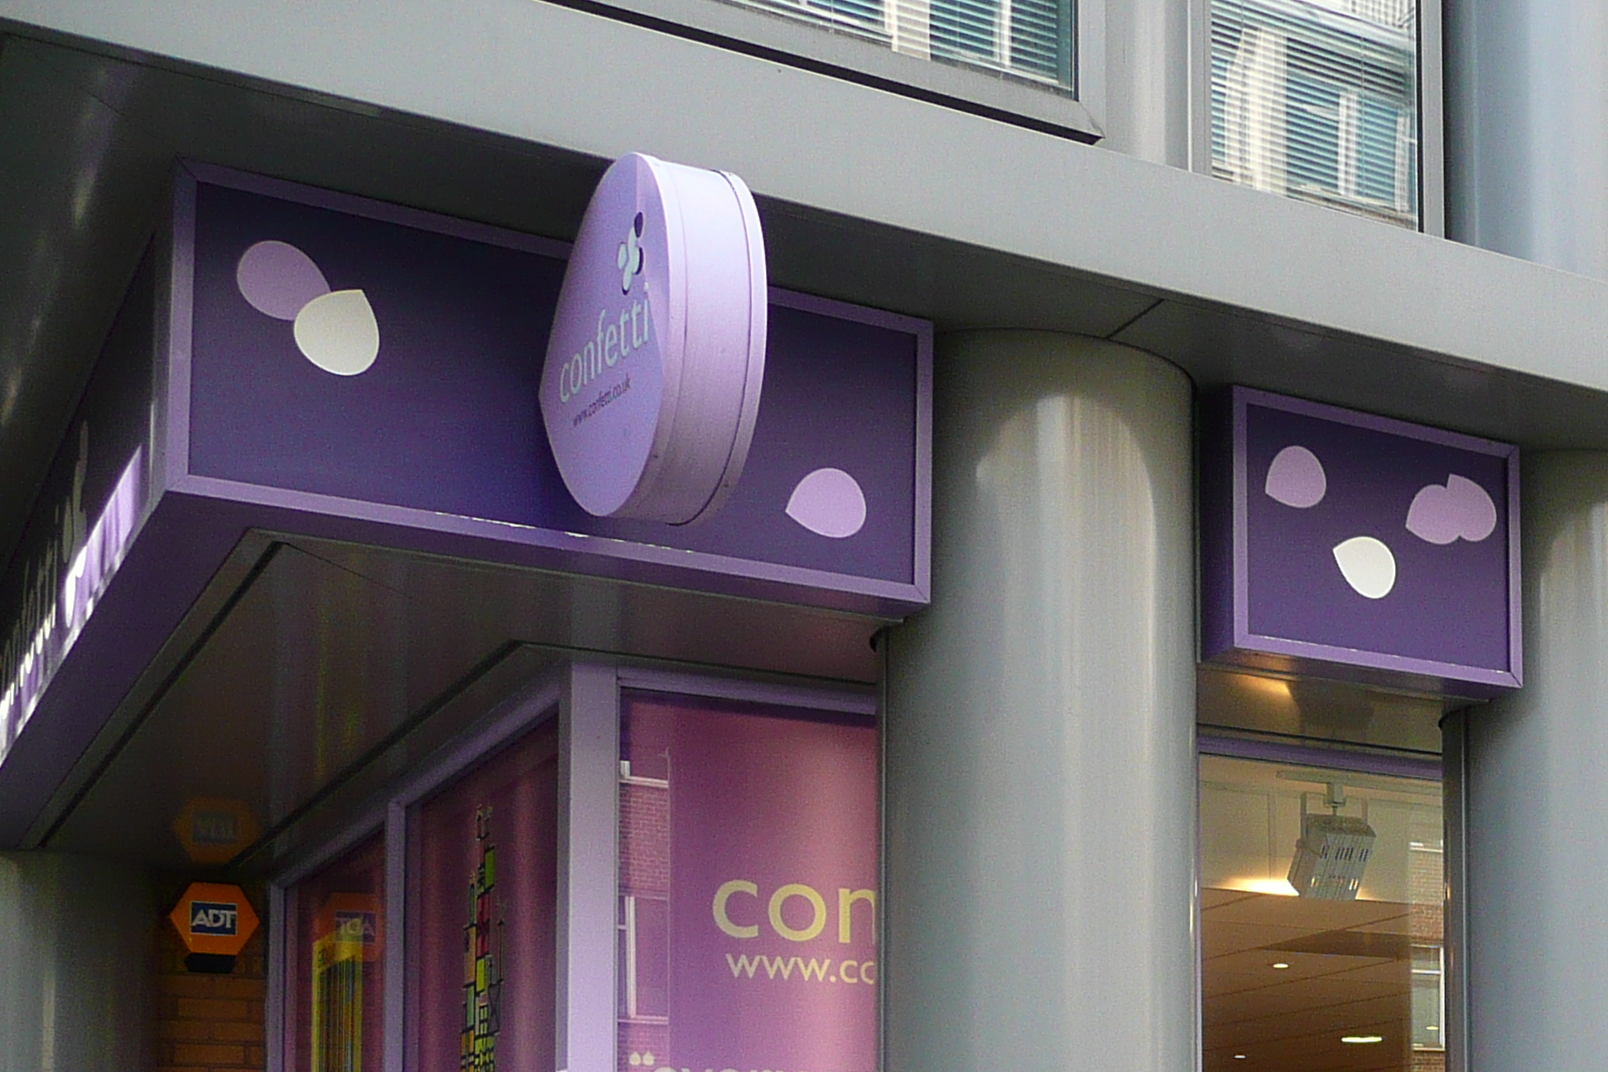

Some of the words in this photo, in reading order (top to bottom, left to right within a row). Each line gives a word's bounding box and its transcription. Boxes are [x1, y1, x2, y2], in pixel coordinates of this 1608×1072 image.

[560, 281, 650, 403] confetti
[573, 374, 632, 426] www.confetti.co.uk
[192, 909, 237, 928] ADT
